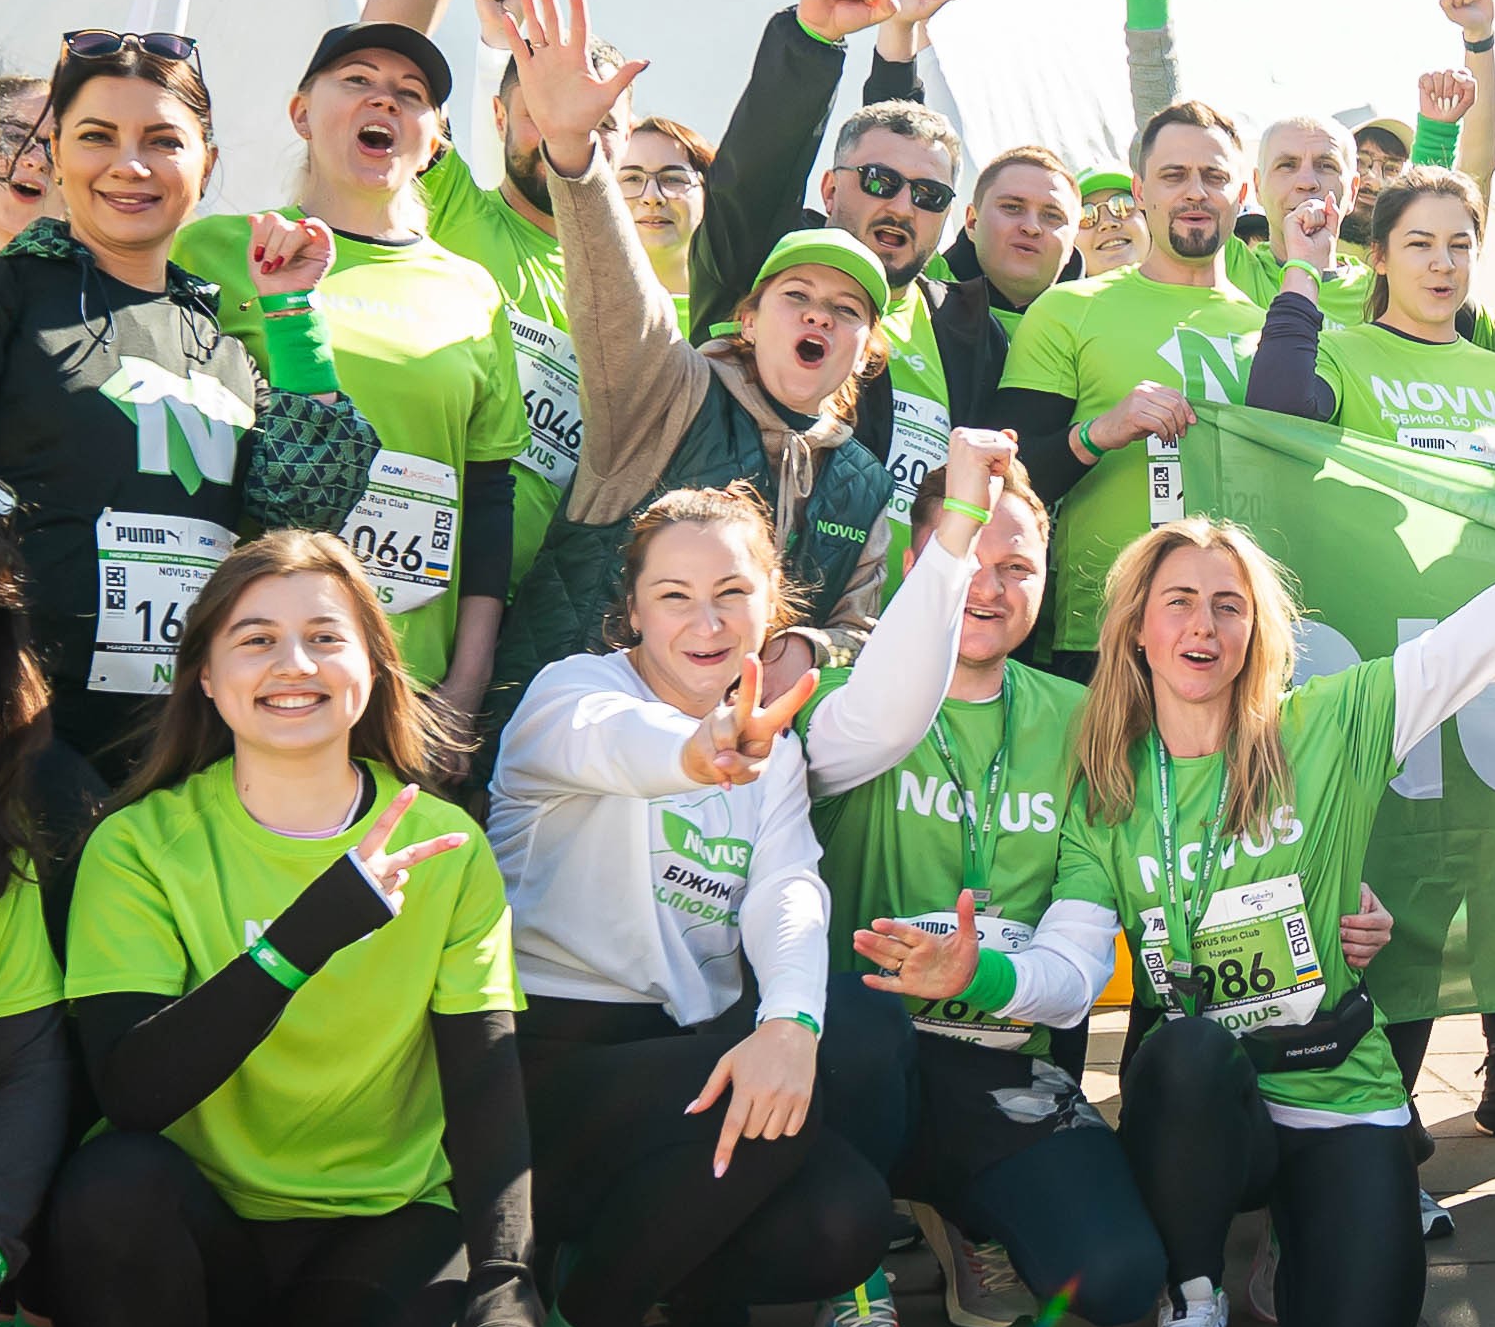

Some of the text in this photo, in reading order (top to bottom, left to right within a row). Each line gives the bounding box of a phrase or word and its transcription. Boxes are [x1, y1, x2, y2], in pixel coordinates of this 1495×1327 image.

[513, 389, 583, 450] 6046
[1452, 415, 1471, 427] БО
[1411, 437, 1445, 450] PUMA
[518, 446, 556, 470] VUS
[381, 464, 403, 475] RUN
[369, 494, 386, 506] Run
[389, 499, 409, 510] Club
[116, 526, 166, 544] PUMA
[817, 520, 866, 543] NOVUS
[341, 525, 422, 572] 066
[158, 567, 191, 578] NOVUS
[663, 864, 736, 901] БІЖИМ
[1221, 934, 1238, 946] Run
[1240, 928, 1260, 940] Club
[1192, 952, 1276, 1007] 986
